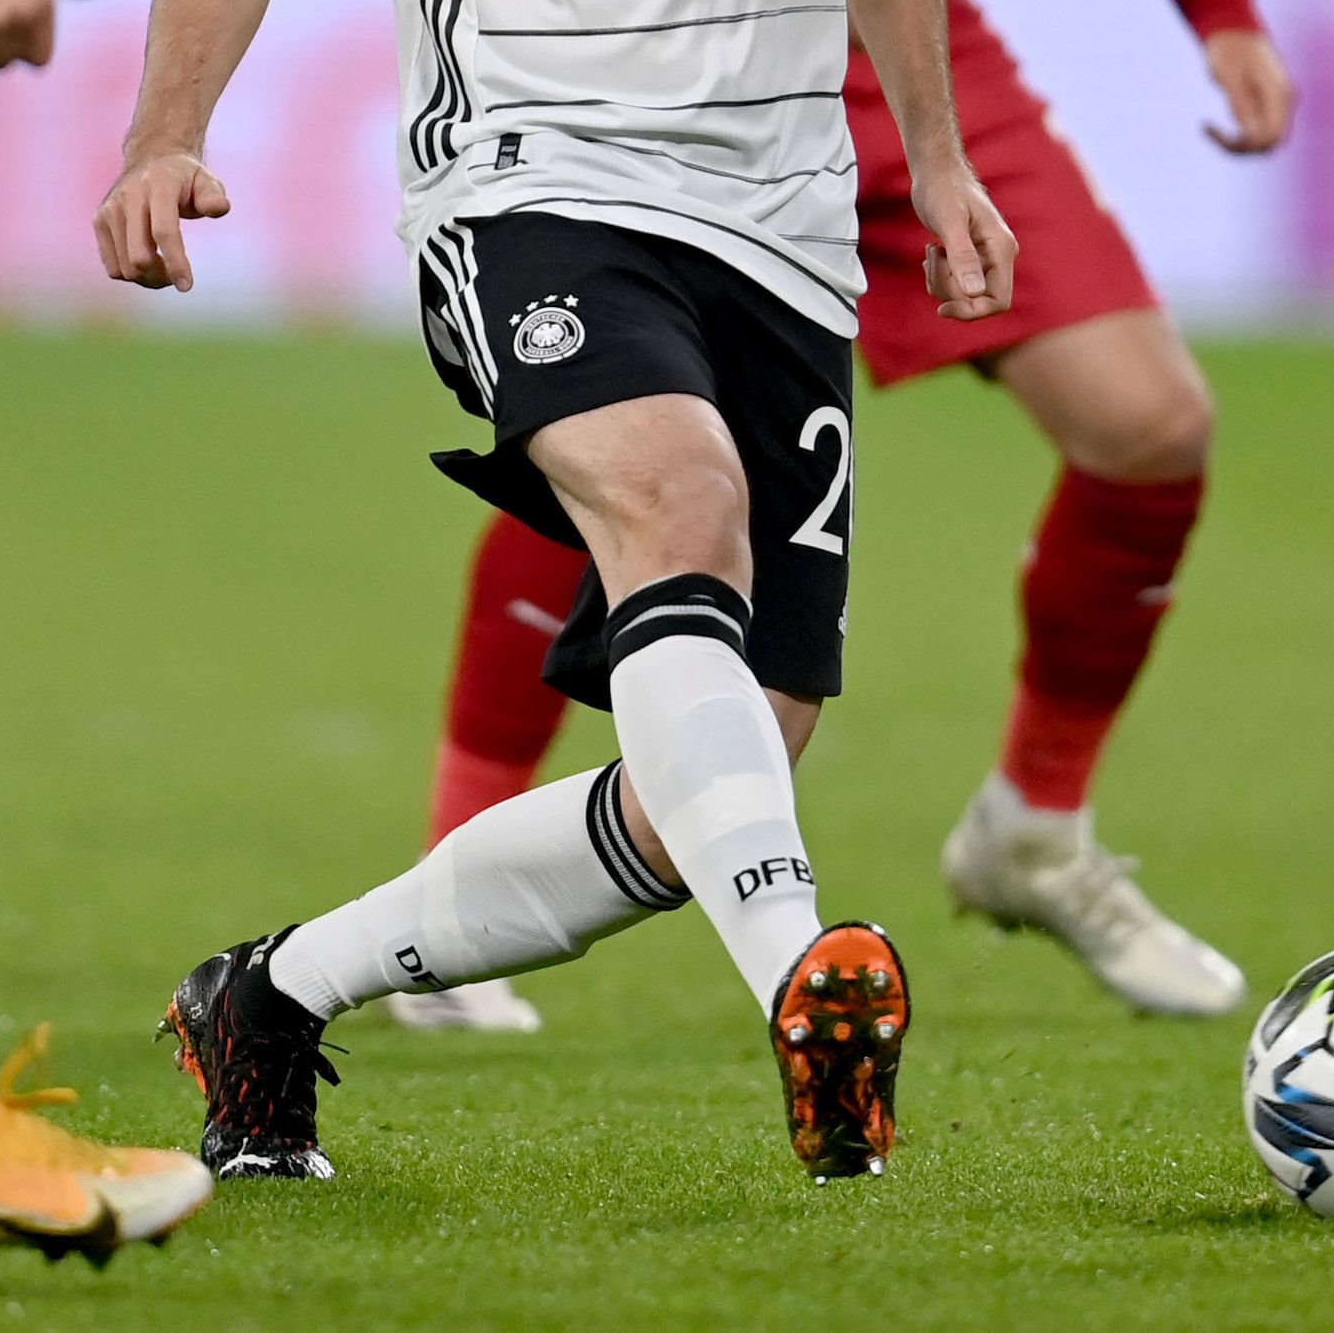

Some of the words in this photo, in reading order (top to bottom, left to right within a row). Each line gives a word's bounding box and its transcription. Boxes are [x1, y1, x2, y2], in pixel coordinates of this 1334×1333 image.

[789, 406, 854, 555] 2
[733, 857, 814, 902] DFB
[395, 945, 446, 988] DF
